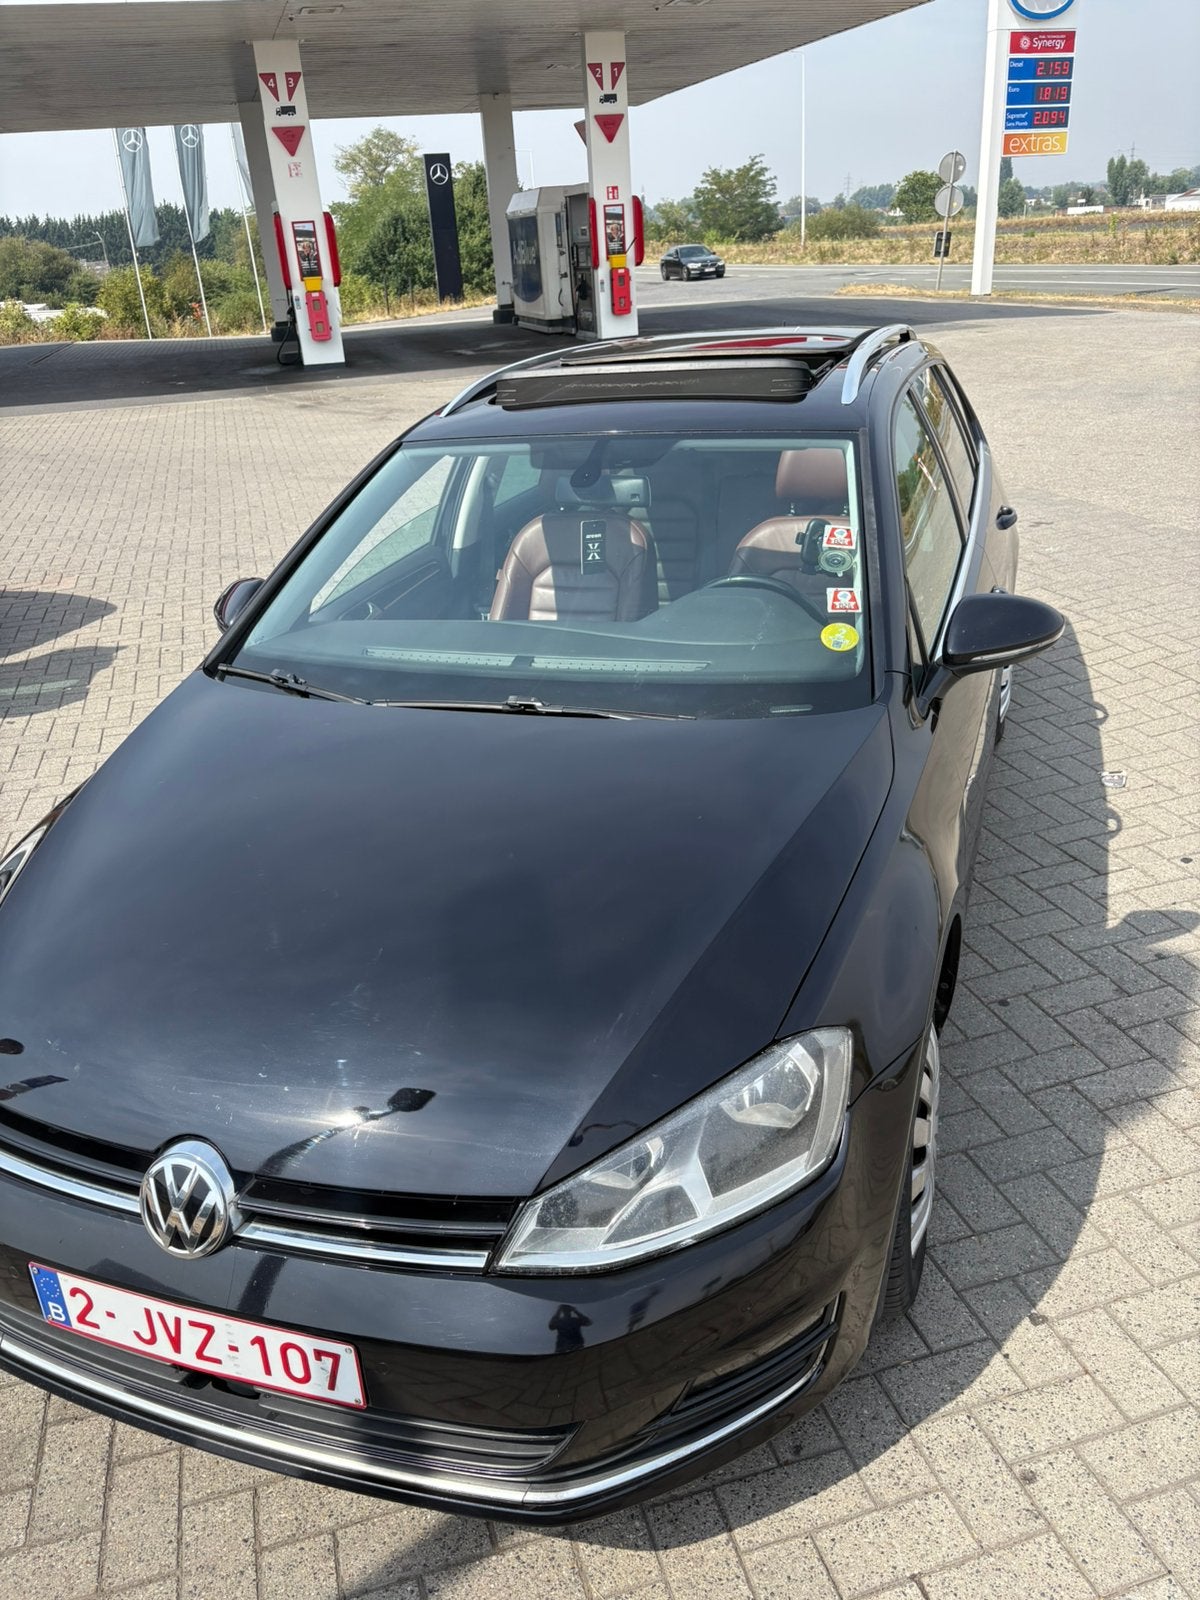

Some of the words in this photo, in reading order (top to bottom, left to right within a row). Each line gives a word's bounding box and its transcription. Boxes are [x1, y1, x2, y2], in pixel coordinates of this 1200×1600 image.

[1033, 37, 1065, 49] Synergy
[1010, 60, 1024, 68] Diesel
[1036, 61, 1070, 75] 2.159
[595, 68, 602, 78] 2
[613, 67, 618, 77] 1
[268, 78, 275, 88] 4
[288, 77, 294, 88] 3
[1039, 86, 1068, 100] 1.819
[1034, 110, 1066, 124] 2.094
[48, 1301, 66, 1322] B
